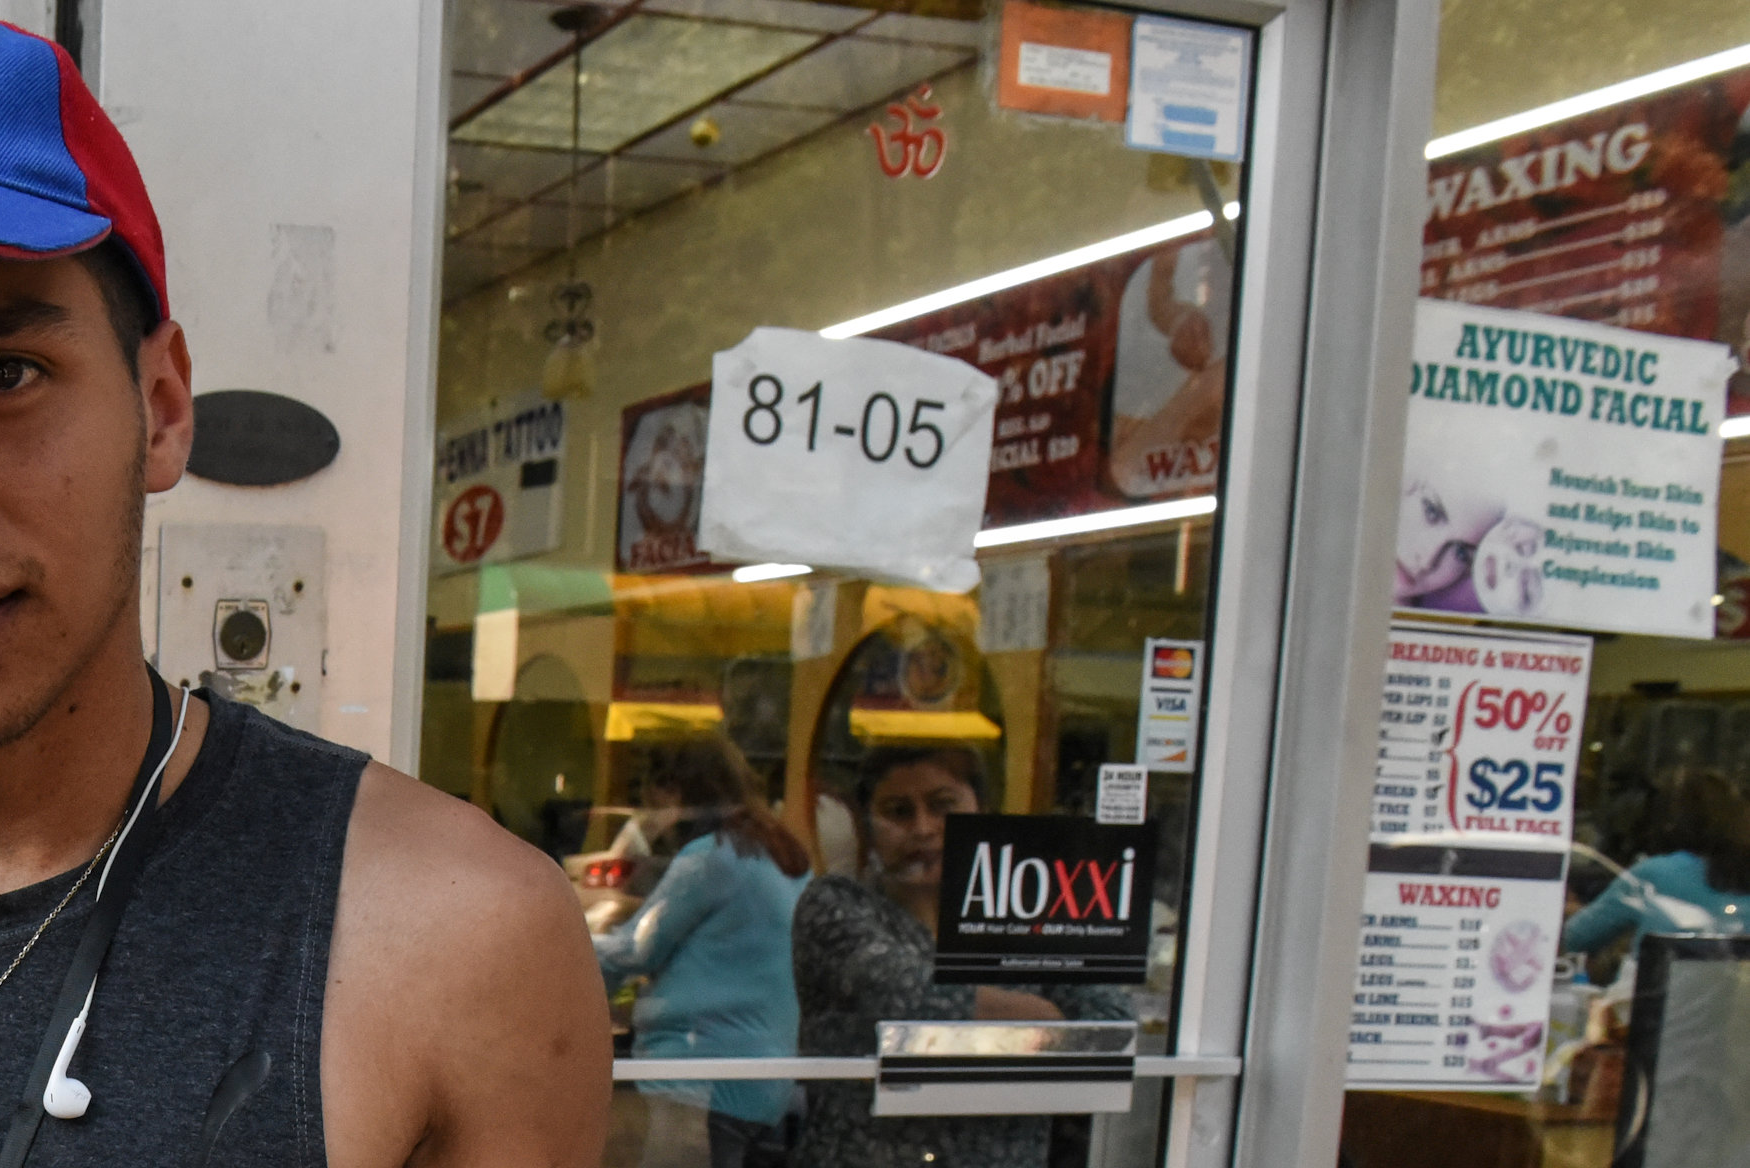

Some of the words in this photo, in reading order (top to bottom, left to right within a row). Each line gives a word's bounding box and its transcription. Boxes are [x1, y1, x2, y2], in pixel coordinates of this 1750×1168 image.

[1028, 350, 1087, 399] OFF
[1454, 322, 1659, 387] AYURVEDIC
[742, 373, 946, 470] 81-05
[1588, 384, 1710, 437] FACIAL
[1500, 651, 1583, 675] WAXING
[1155, 696, 1187, 713] VISA
[1473, 686, 1573, 735] 50%
[1464, 756, 1566, 816] $25
[1464, 815, 1512, 834] FULL
[1515, 816, 1563, 836] FACE
[960, 840, 1137, 922] Aloxxi
[1397, 881, 1502, 910] WAXING
